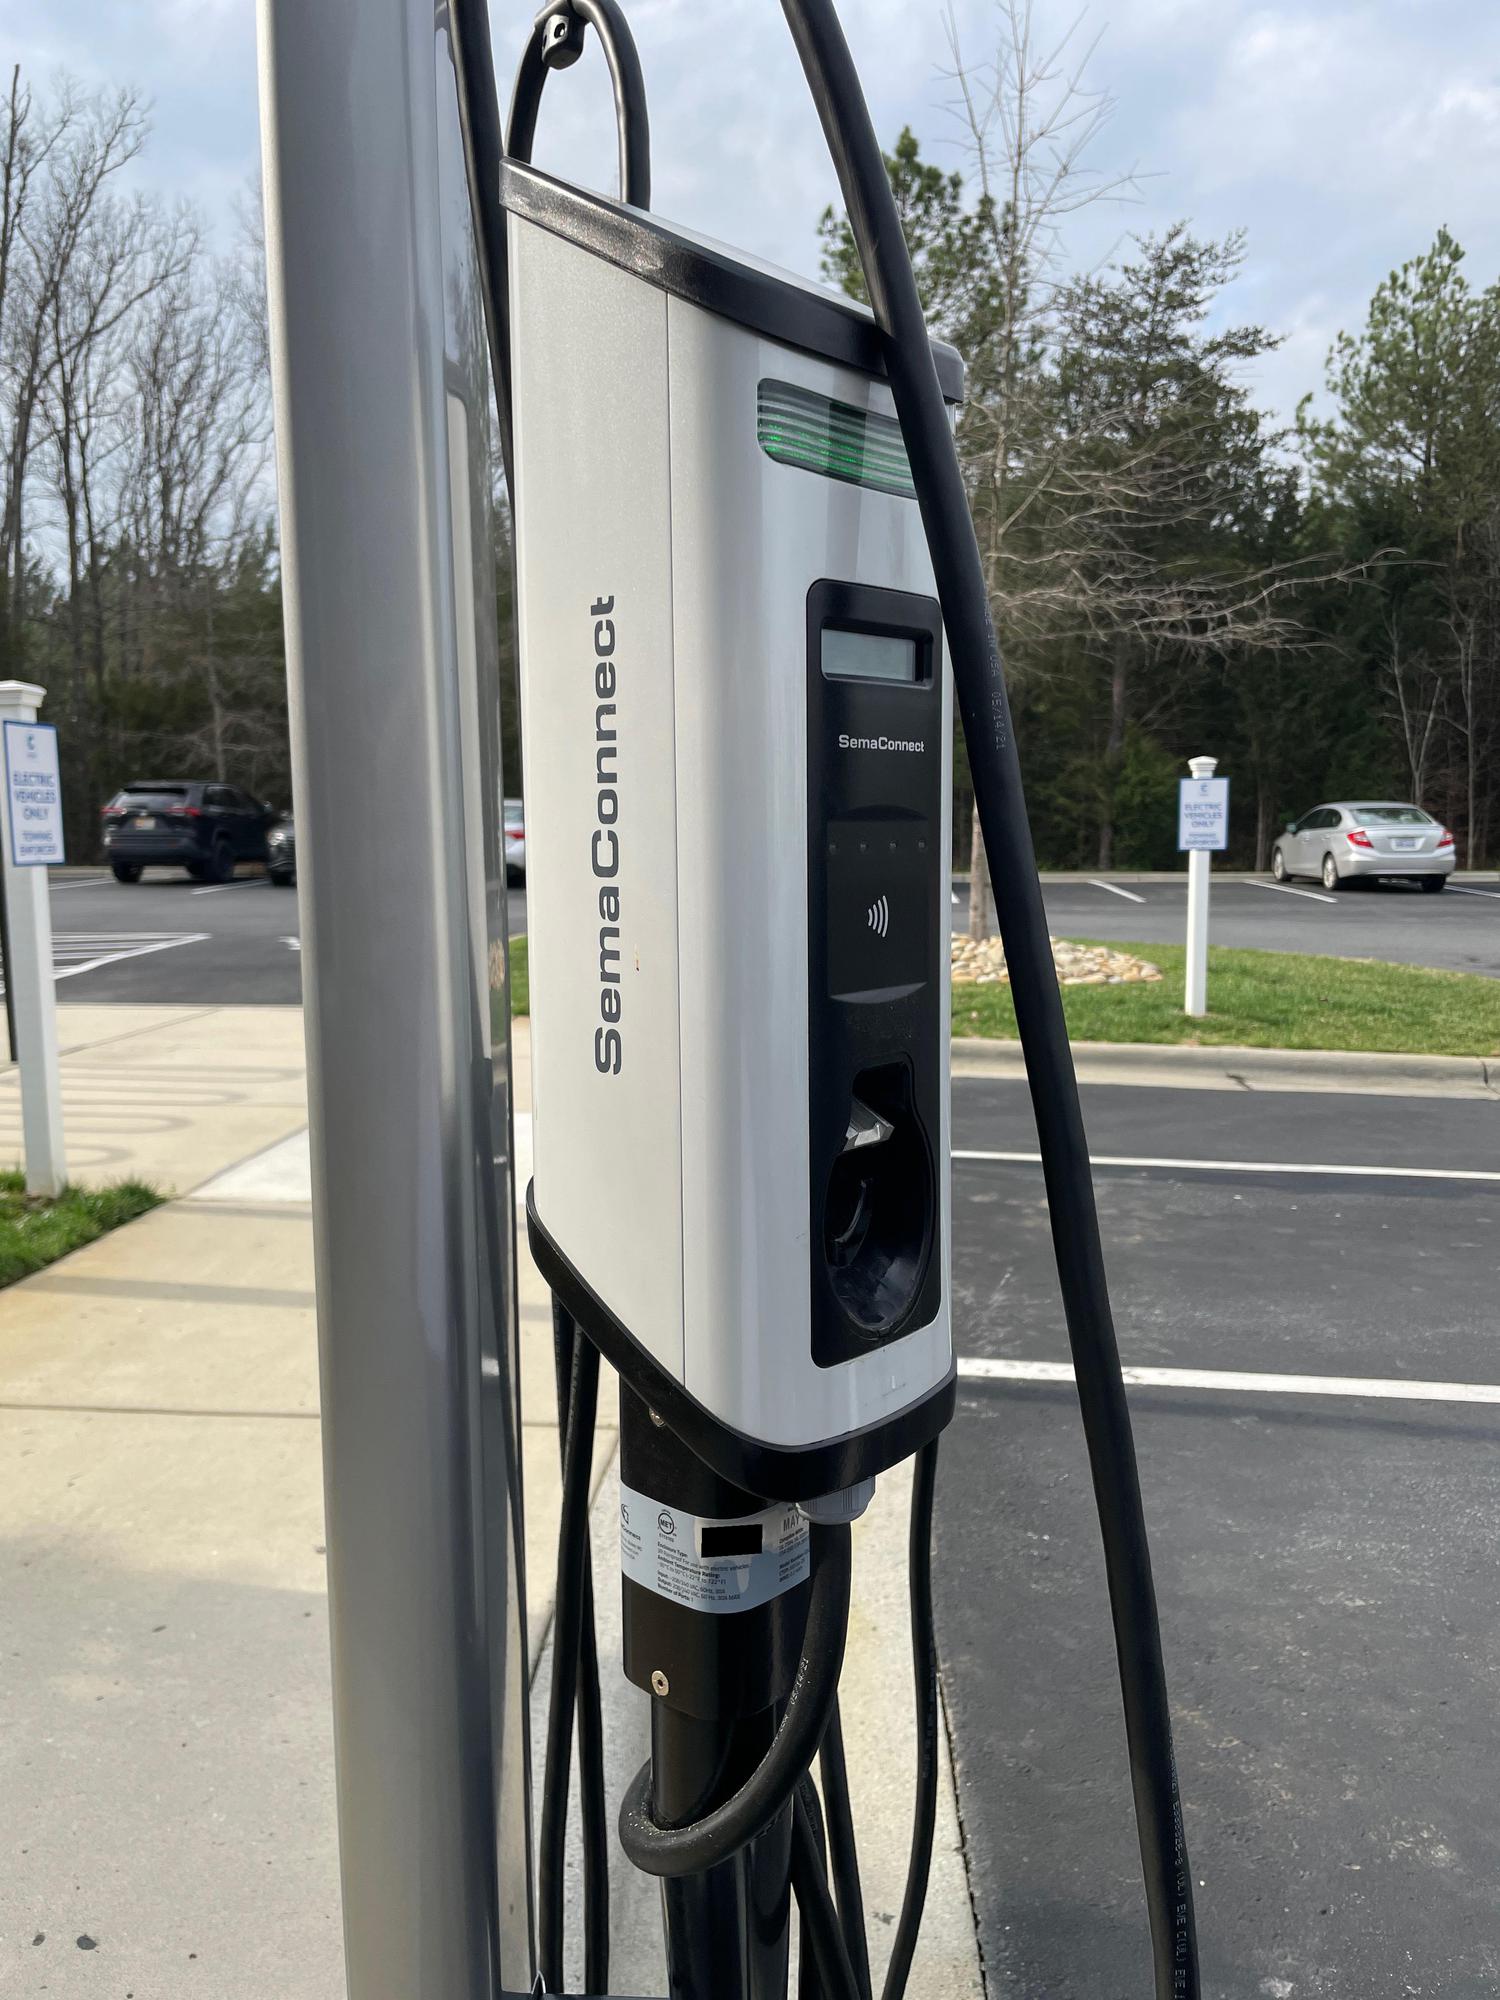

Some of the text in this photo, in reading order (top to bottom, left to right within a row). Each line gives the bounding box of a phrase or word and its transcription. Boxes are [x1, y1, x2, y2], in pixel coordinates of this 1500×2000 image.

[838, 734, 925, 753] SemaConnect
[13, 770, 55, 787] ELECTRIC
[15, 790, 56, 804] VEHICLES
[23, 807, 49, 820] ONLY
[1184, 803, 1223, 811] ELECTRIC
[1191, 820, 1215, 828] ONLY
[591, 595, 622, 1075] SemaConnect
[660, 1518, 673, 1530] MET
[783, 1513, 800, 1531] MAY
